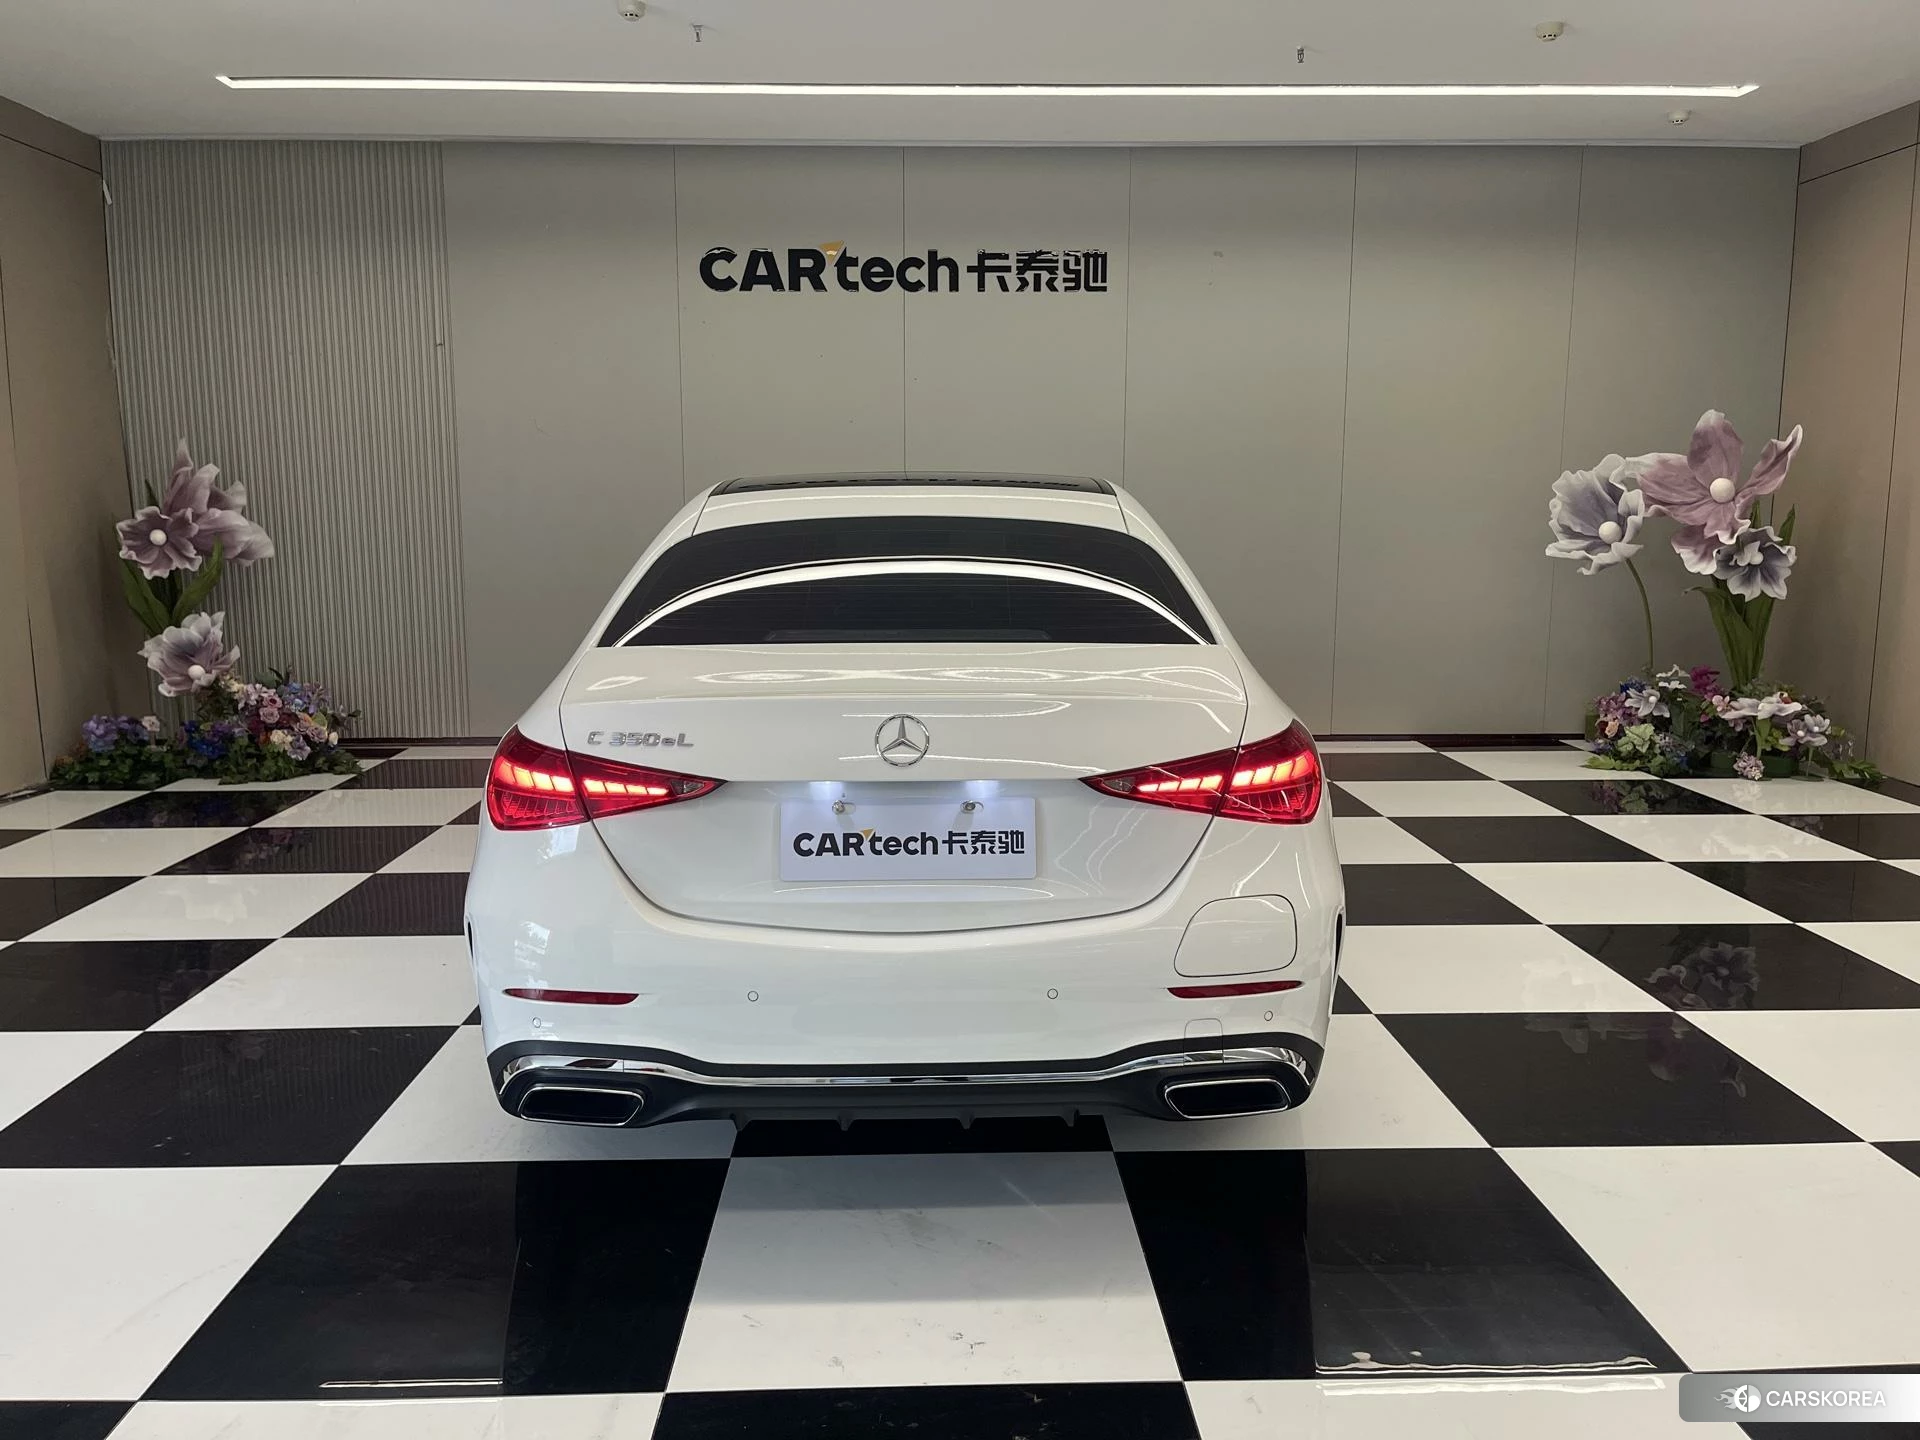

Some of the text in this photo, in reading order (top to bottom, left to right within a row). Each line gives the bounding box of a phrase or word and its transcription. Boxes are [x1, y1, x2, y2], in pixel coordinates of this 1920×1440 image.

[700, 246, 1108, 292] CARtech 卡泰驰
[587, 731, 604, 745] C
[793, 830, 1025, 857] CARtech 卡泰驰
